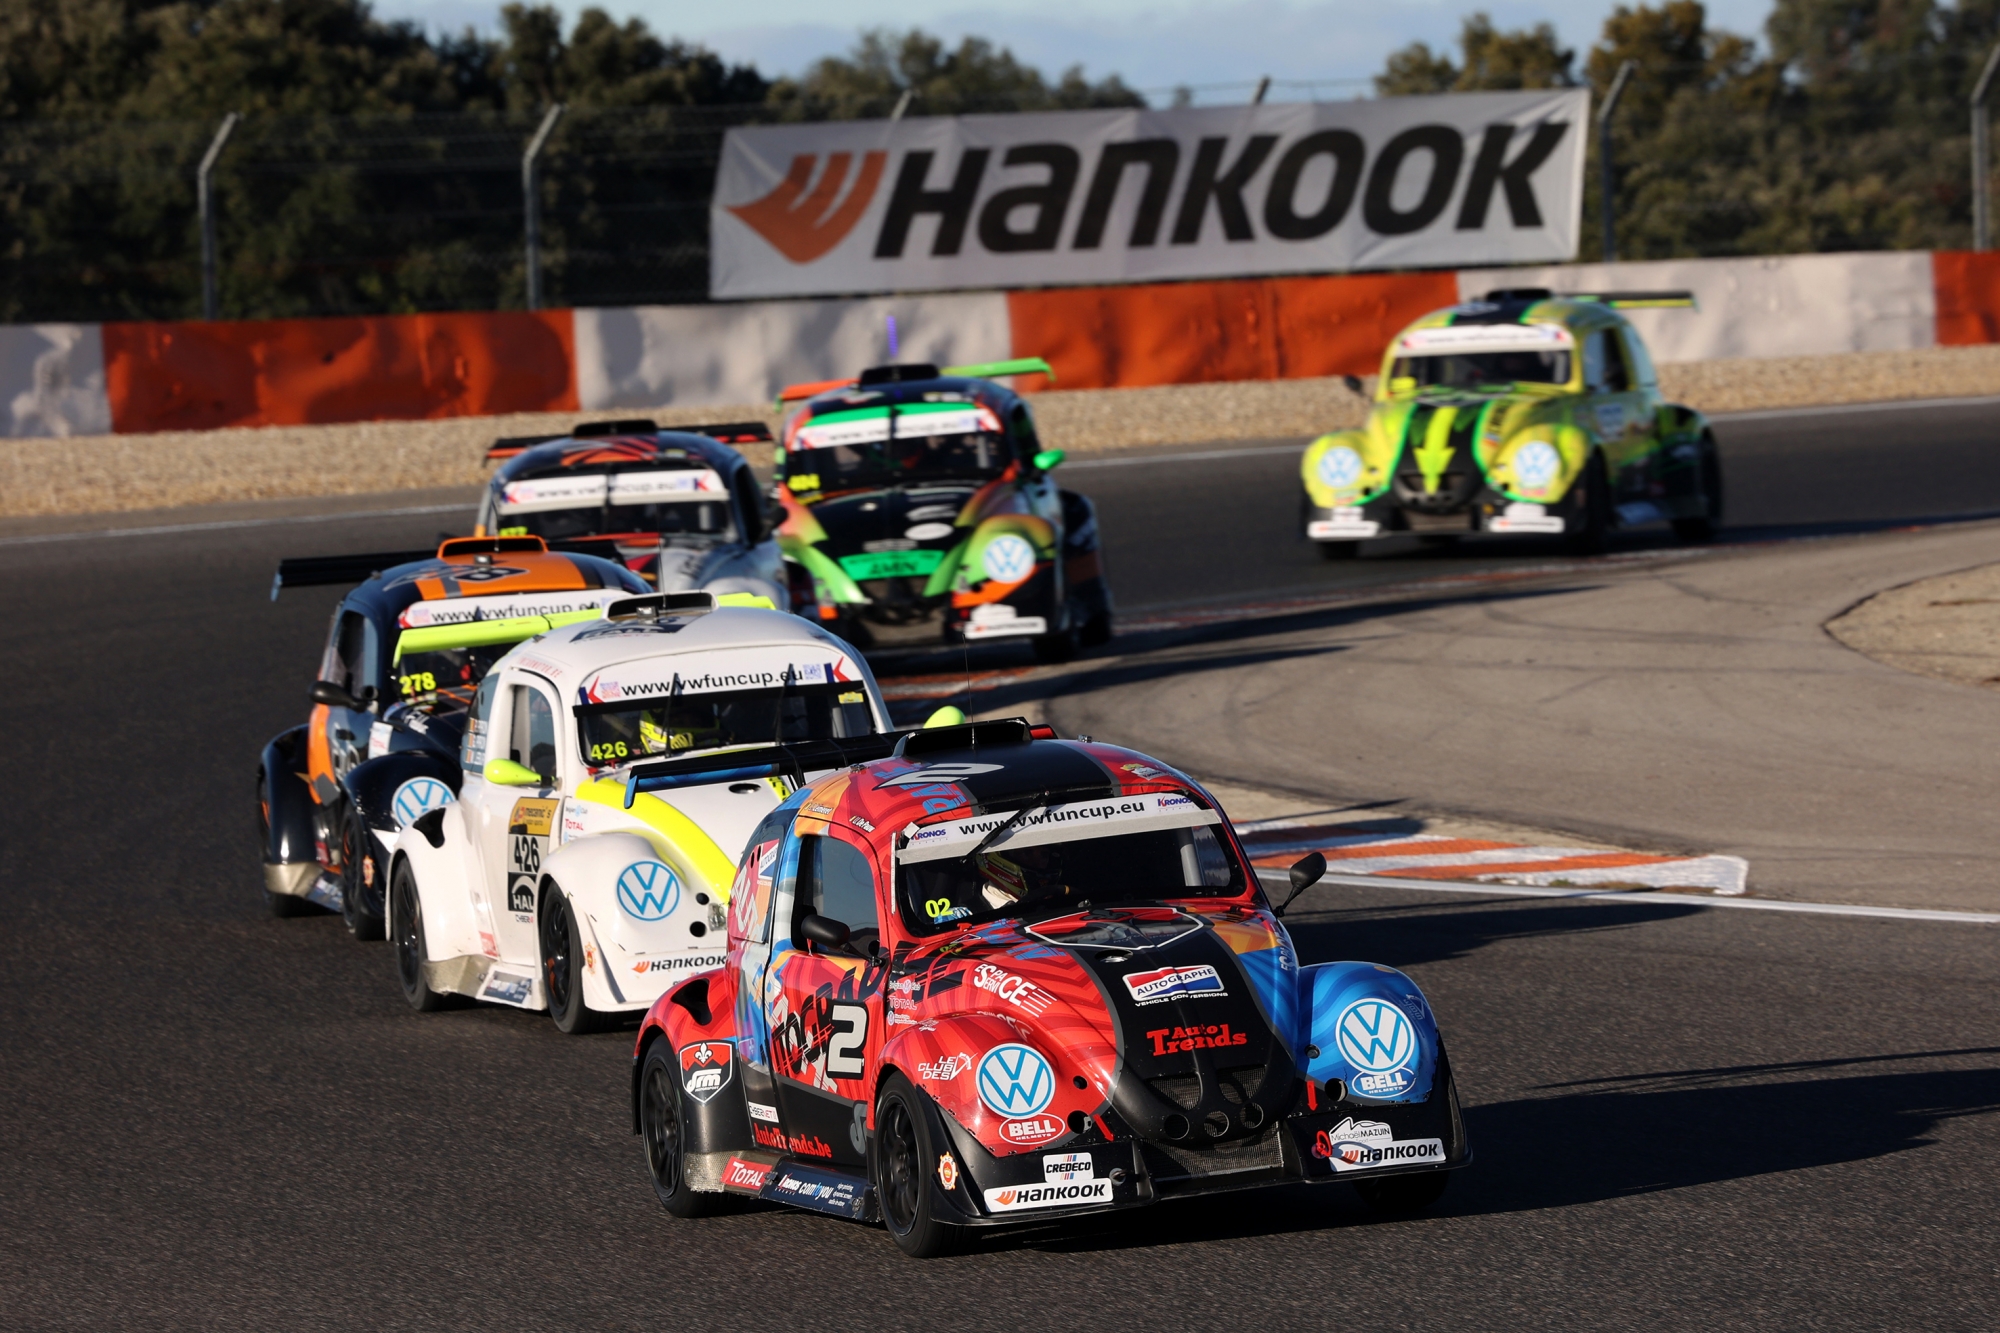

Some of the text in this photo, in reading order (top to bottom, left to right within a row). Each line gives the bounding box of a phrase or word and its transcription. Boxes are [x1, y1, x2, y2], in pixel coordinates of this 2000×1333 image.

[400, 672, 436, 694] 278
[590, 741, 628, 760] 426
[514, 836, 540, 873] 426
[925, 898, 953, 918] 02
[1137, 968, 1214, 996] AUTOGRAPHE
[888, 995, 917, 1011] TOTAL
[1135, 997, 1169, 1008] VEHICLE
[828, 1005, 868, 1074] 2
[1147, 1024, 1247, 1056] Trends
[1171, 1024, 1218, 1040] Auto
[918, 1063, 954, 1072] CLUB
[938, 1055, 956, 1065] LE
[922, 1071, 951, 1080] DES
[1360, 1072, 1407, 1091] BELL
[1369, 1086, 1403, 1094] HELMETS
[1008, 1119, 1056, 1137] BELL
[731, 1162, 765, 1187] TOTAL
[1045, 1161, 1092, 1174] CREDECO
